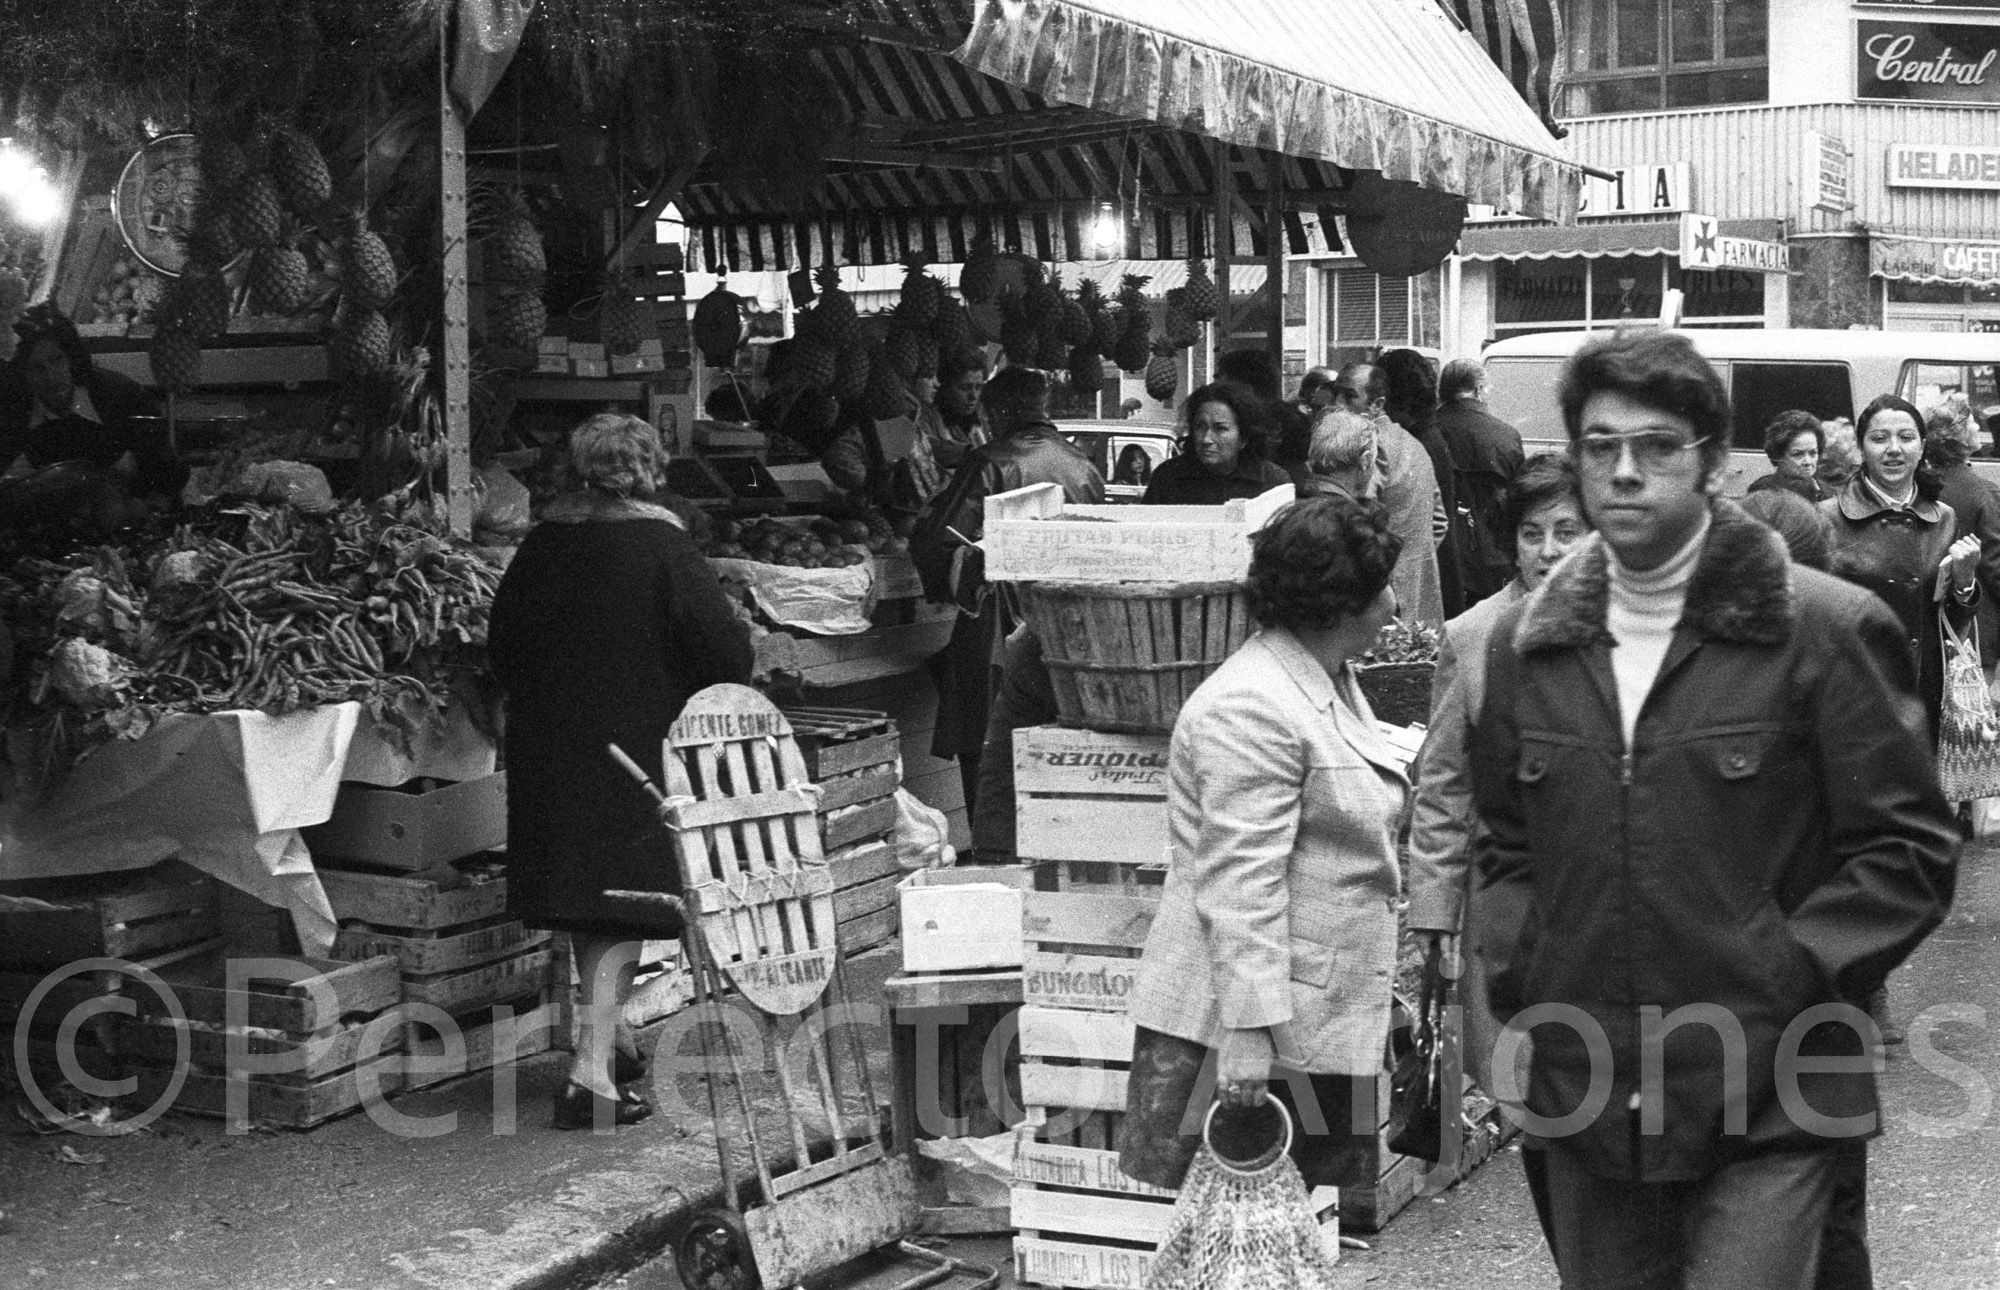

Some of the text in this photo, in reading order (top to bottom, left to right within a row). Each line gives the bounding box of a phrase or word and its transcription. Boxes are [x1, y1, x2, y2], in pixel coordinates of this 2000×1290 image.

[1865, 33, 1997, 85] Central
[1899, 151, 2000, 182] HELADE
[1723, 240, 1789, 269] FARMACIA
[1046, 752, 1161, 768] PIQUER
